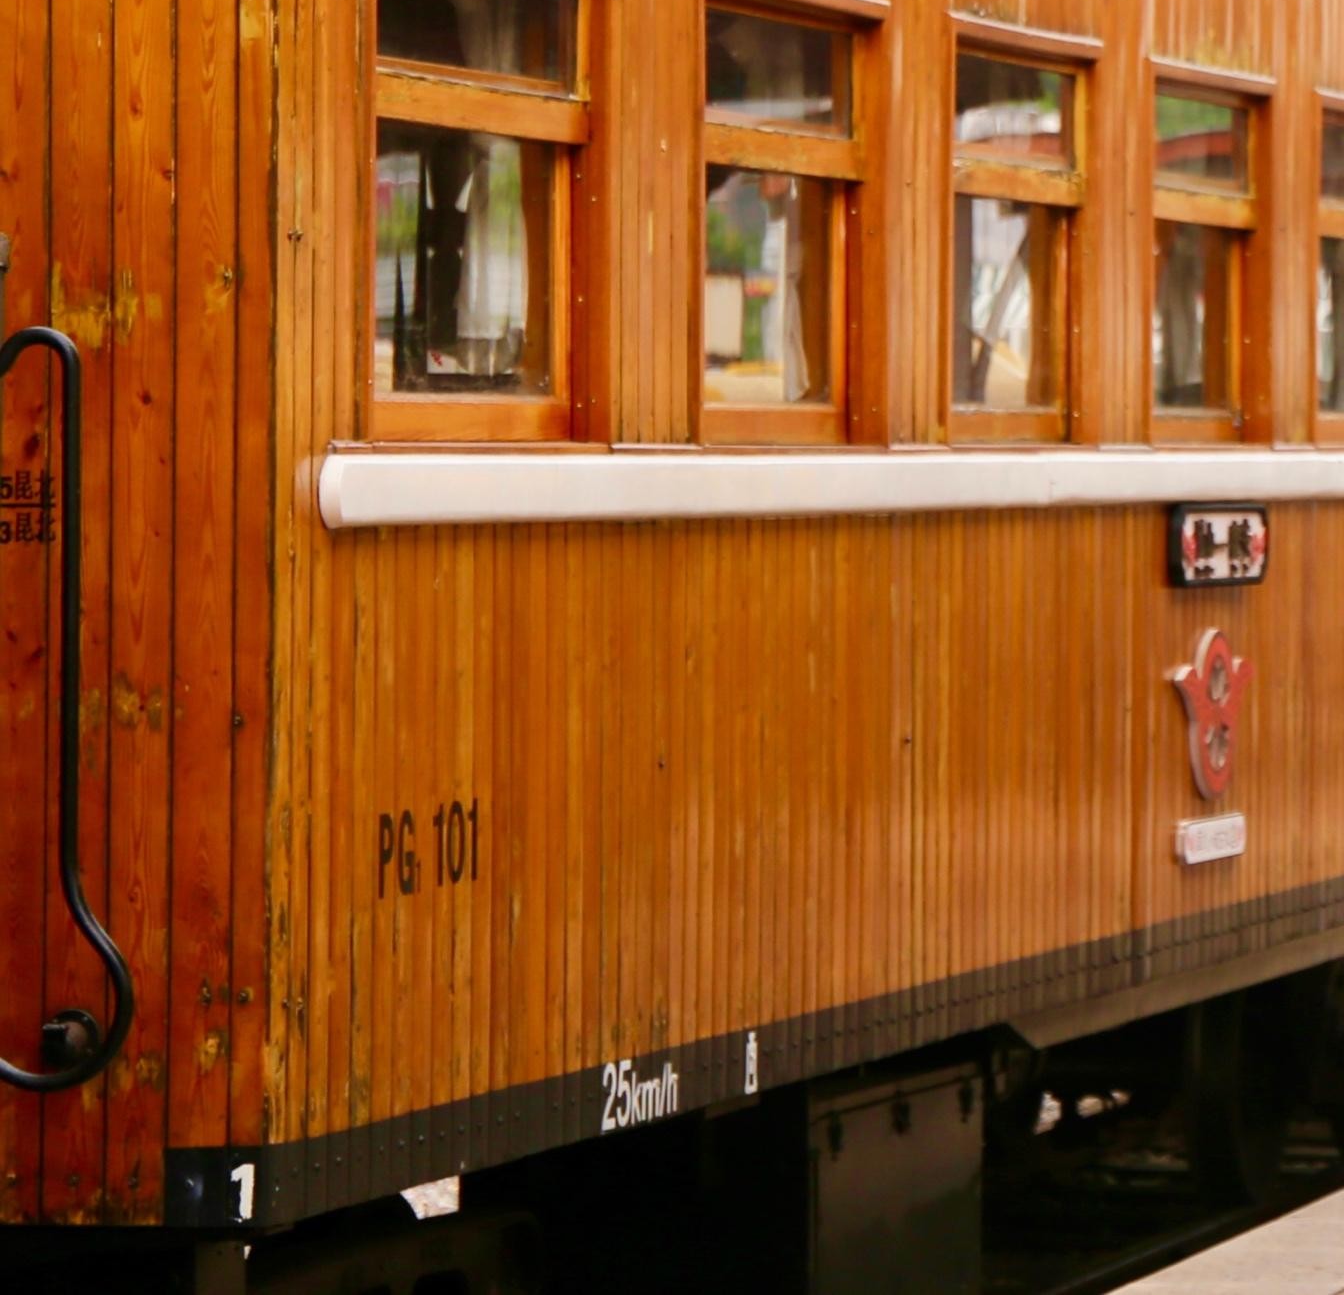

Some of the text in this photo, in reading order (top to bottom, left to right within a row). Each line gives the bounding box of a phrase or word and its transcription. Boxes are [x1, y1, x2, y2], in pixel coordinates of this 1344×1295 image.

[432, 796, 479, 888] 101
[601, 1058, 680, 1133] 25km/h
[230, 1163, 256, 1221] 1
